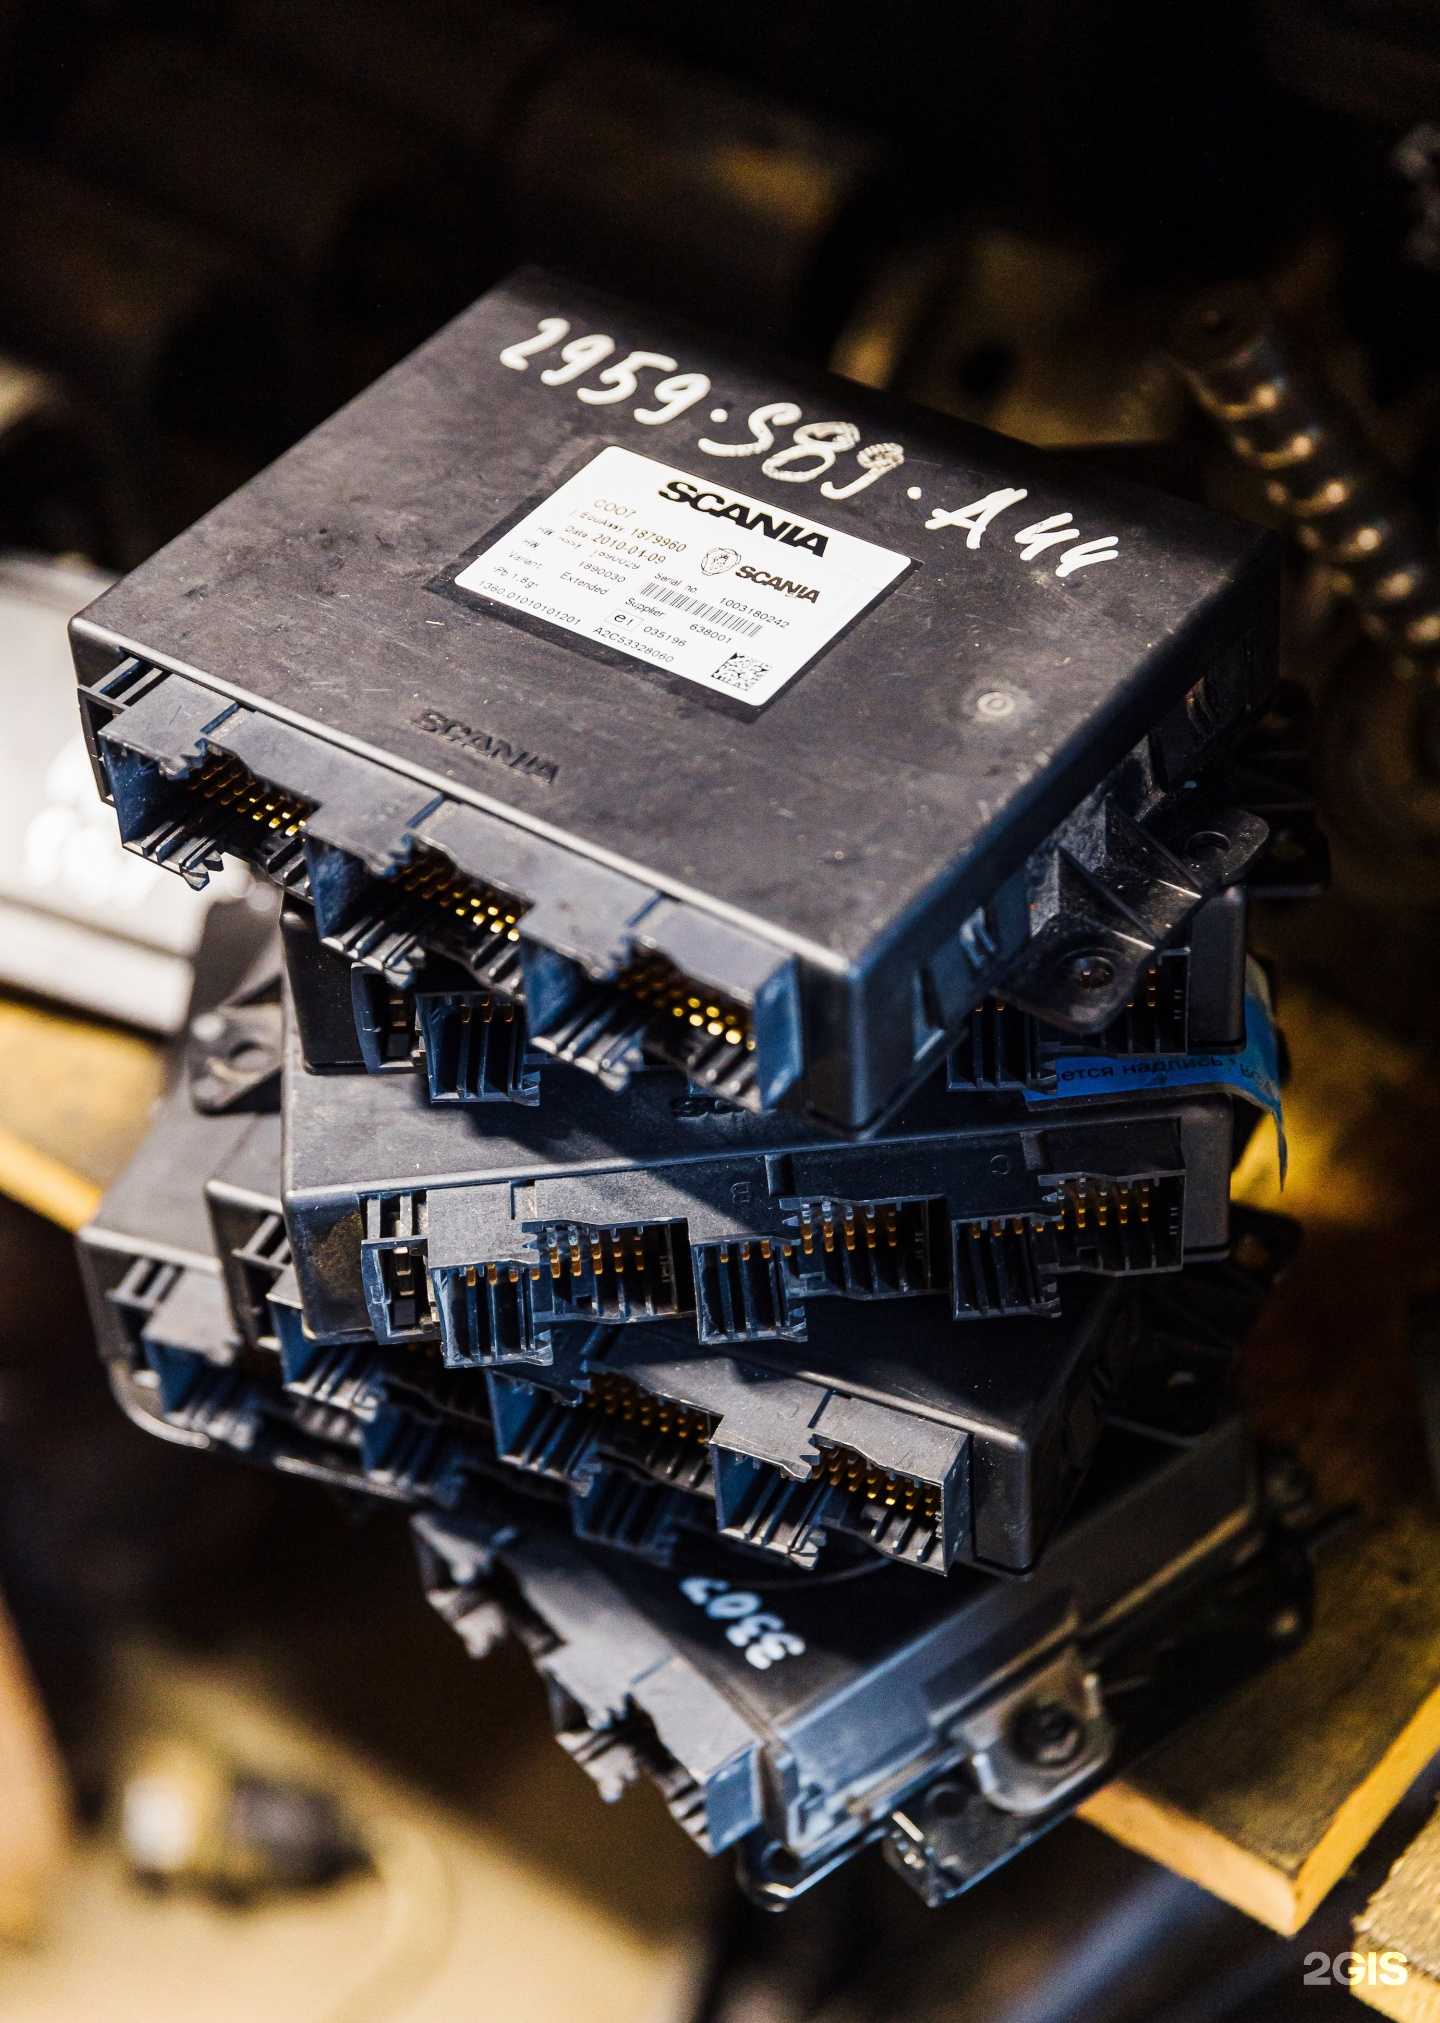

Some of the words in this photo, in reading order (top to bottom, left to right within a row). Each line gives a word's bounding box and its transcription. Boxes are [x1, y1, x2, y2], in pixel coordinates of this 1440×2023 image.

[658, 481, 829, 558] SCANIA
[735, 565, 820, 604] SCANIA
[559, 571, 608, 597] Extended
[625, 597, 665, 618] Supplier
[689, 623, 733, 644] 638001
[719, 597, 791, 629] 1003180242
[592, 626, 676, 664] A2C53328060
[643, 625, 688, 648] 035196
[410, 708, 560, 785] SCANIA
